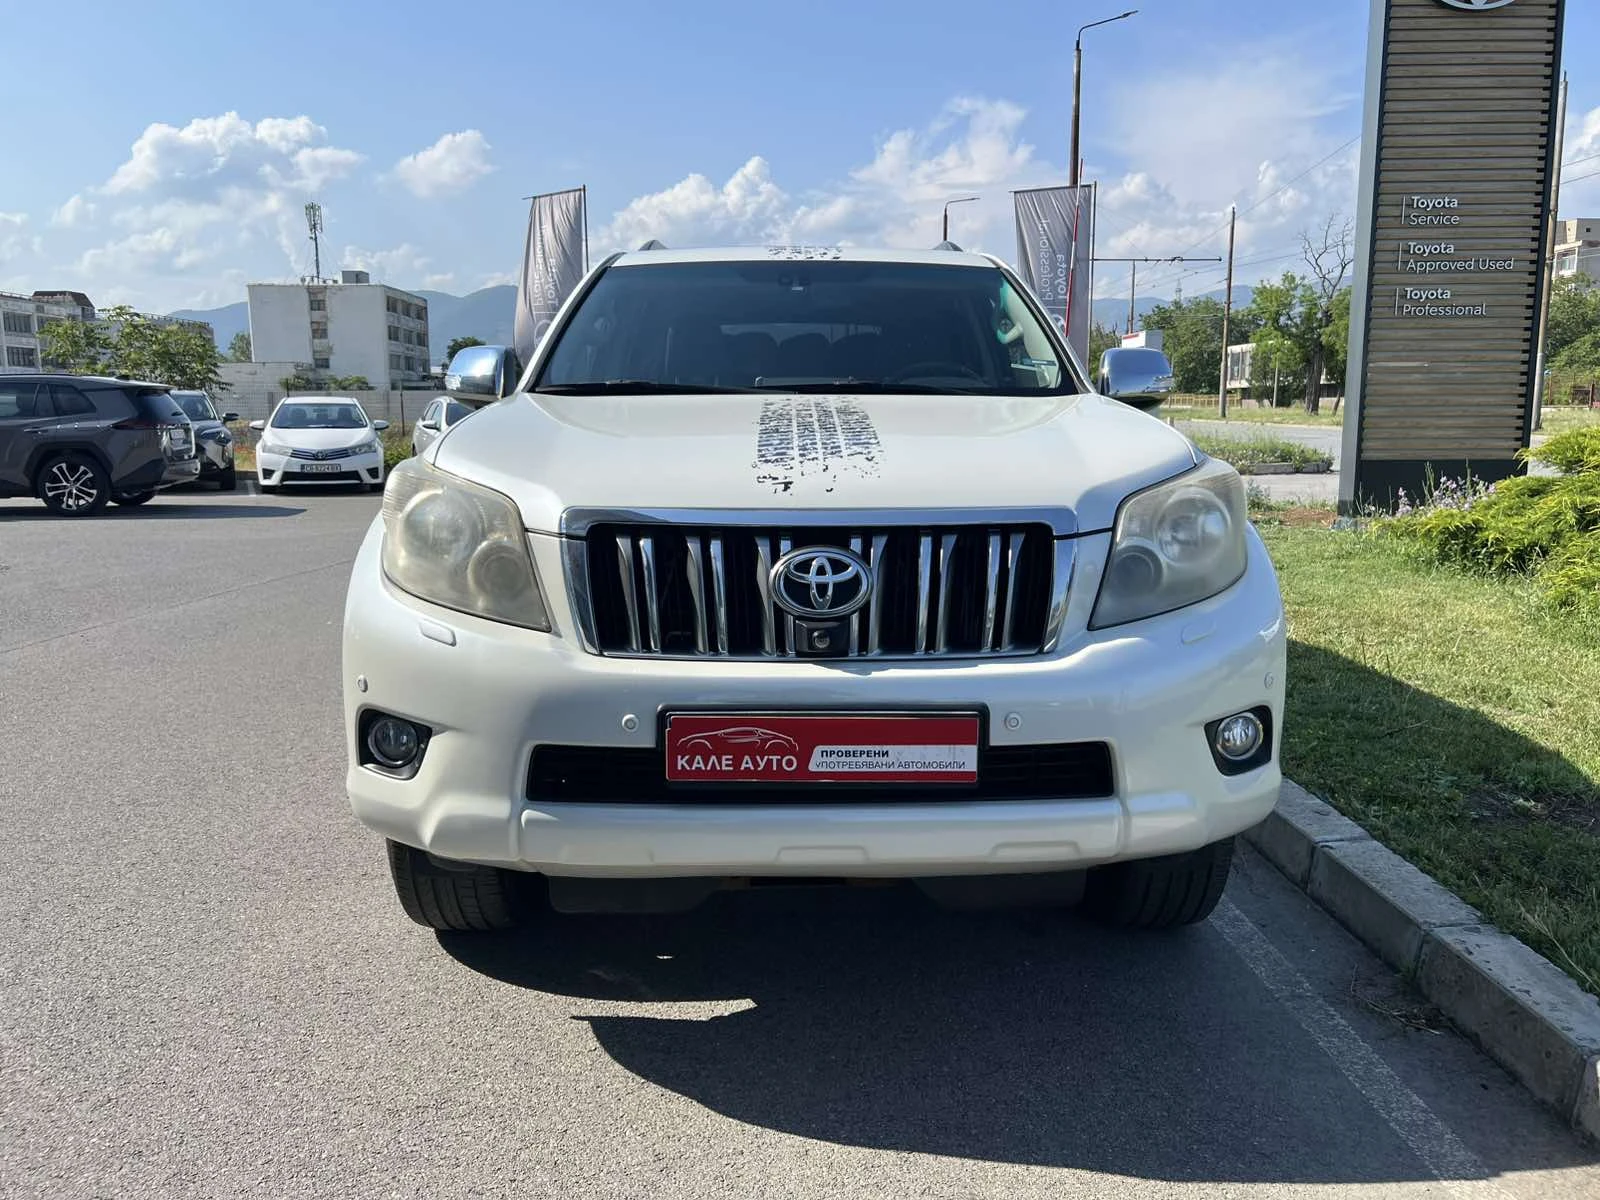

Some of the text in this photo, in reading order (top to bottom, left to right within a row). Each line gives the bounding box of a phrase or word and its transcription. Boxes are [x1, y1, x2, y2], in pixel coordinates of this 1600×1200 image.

[1411, 196, 1459, 211] Toyota
[1409, 212, 1460, 225] Service
[1407, 242, 1455, 257] Toyota
[1406, 257, 1514, 274] Approved Used
[1404, 287, 1451, 302] Toyota
[1402, 302, 1487, 316] Professional
[820, 749, 889, 758] ПРОВЕРЕНИ
[676, 755, 798, 772] КАЛЕ АУТО
[815, 760, 966, 770] УПОТРЕБЯВАНИ АВТОМОБИЛИ
